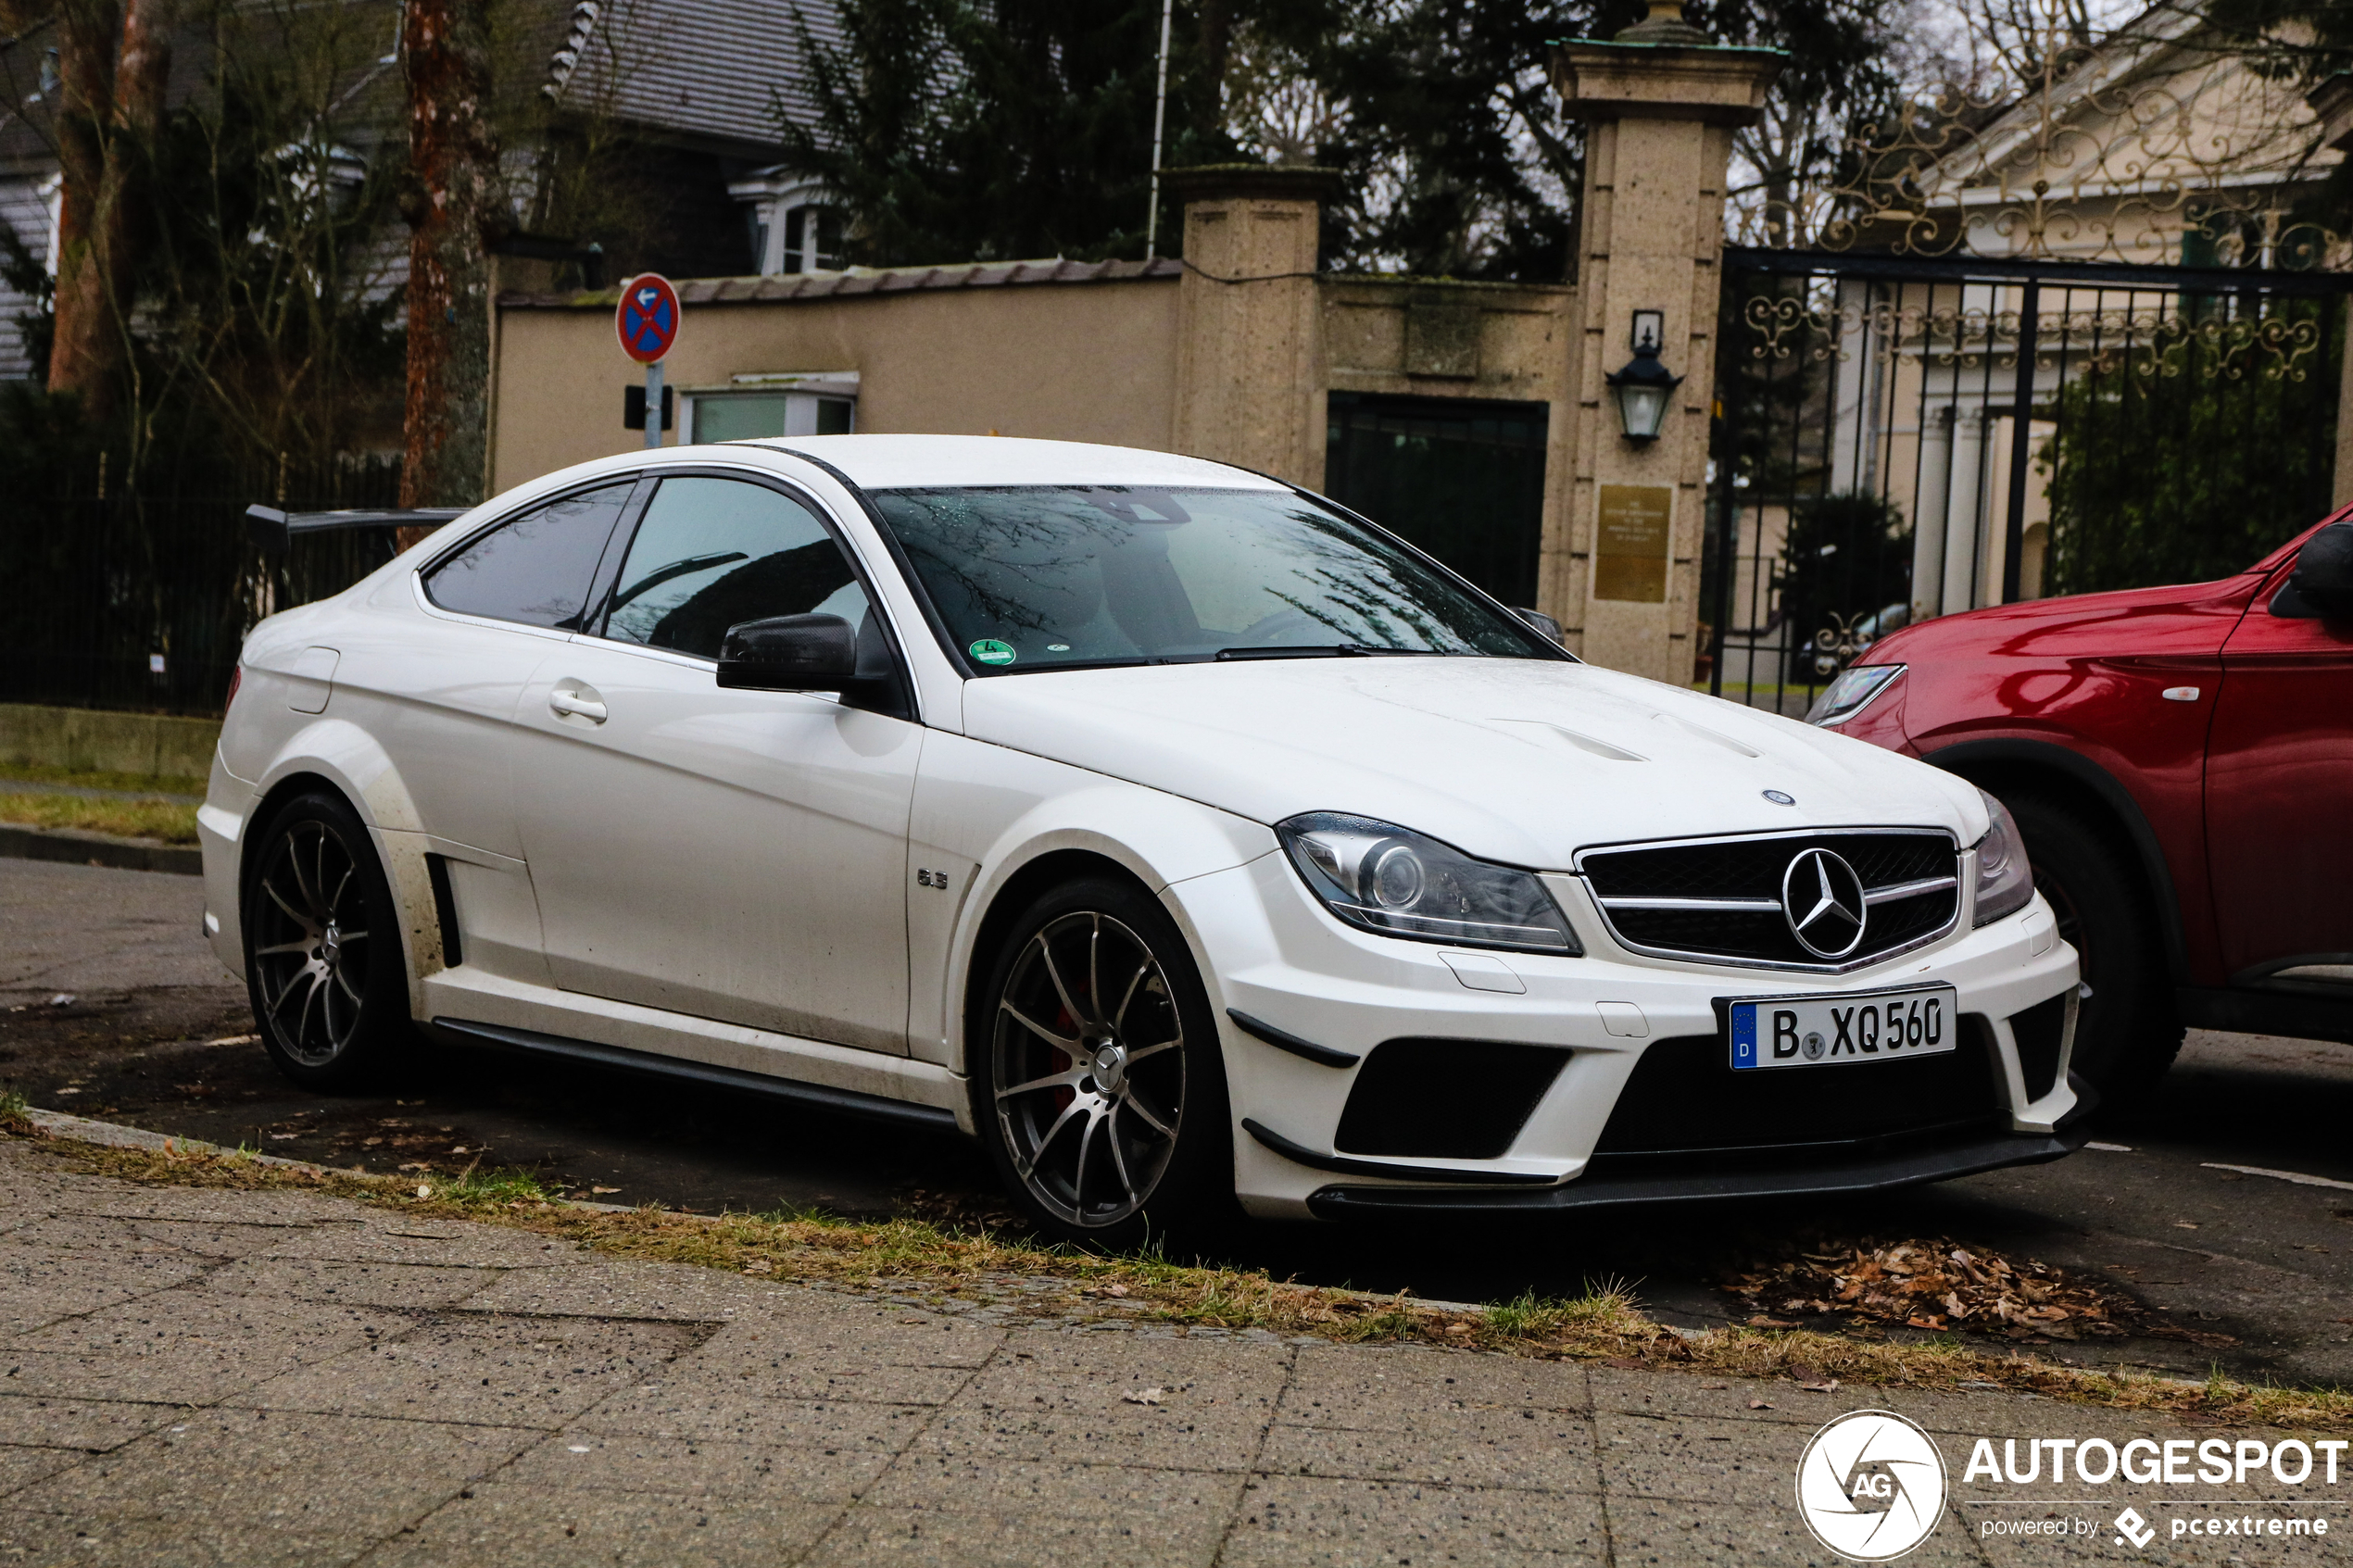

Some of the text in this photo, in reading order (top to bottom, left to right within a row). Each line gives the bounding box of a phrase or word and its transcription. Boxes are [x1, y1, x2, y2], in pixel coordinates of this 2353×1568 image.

[917, 868, 948, 890] 6.3
[1773, 1010, 1800, 1059] B
[1739, 1043, 1749, 1058] D
